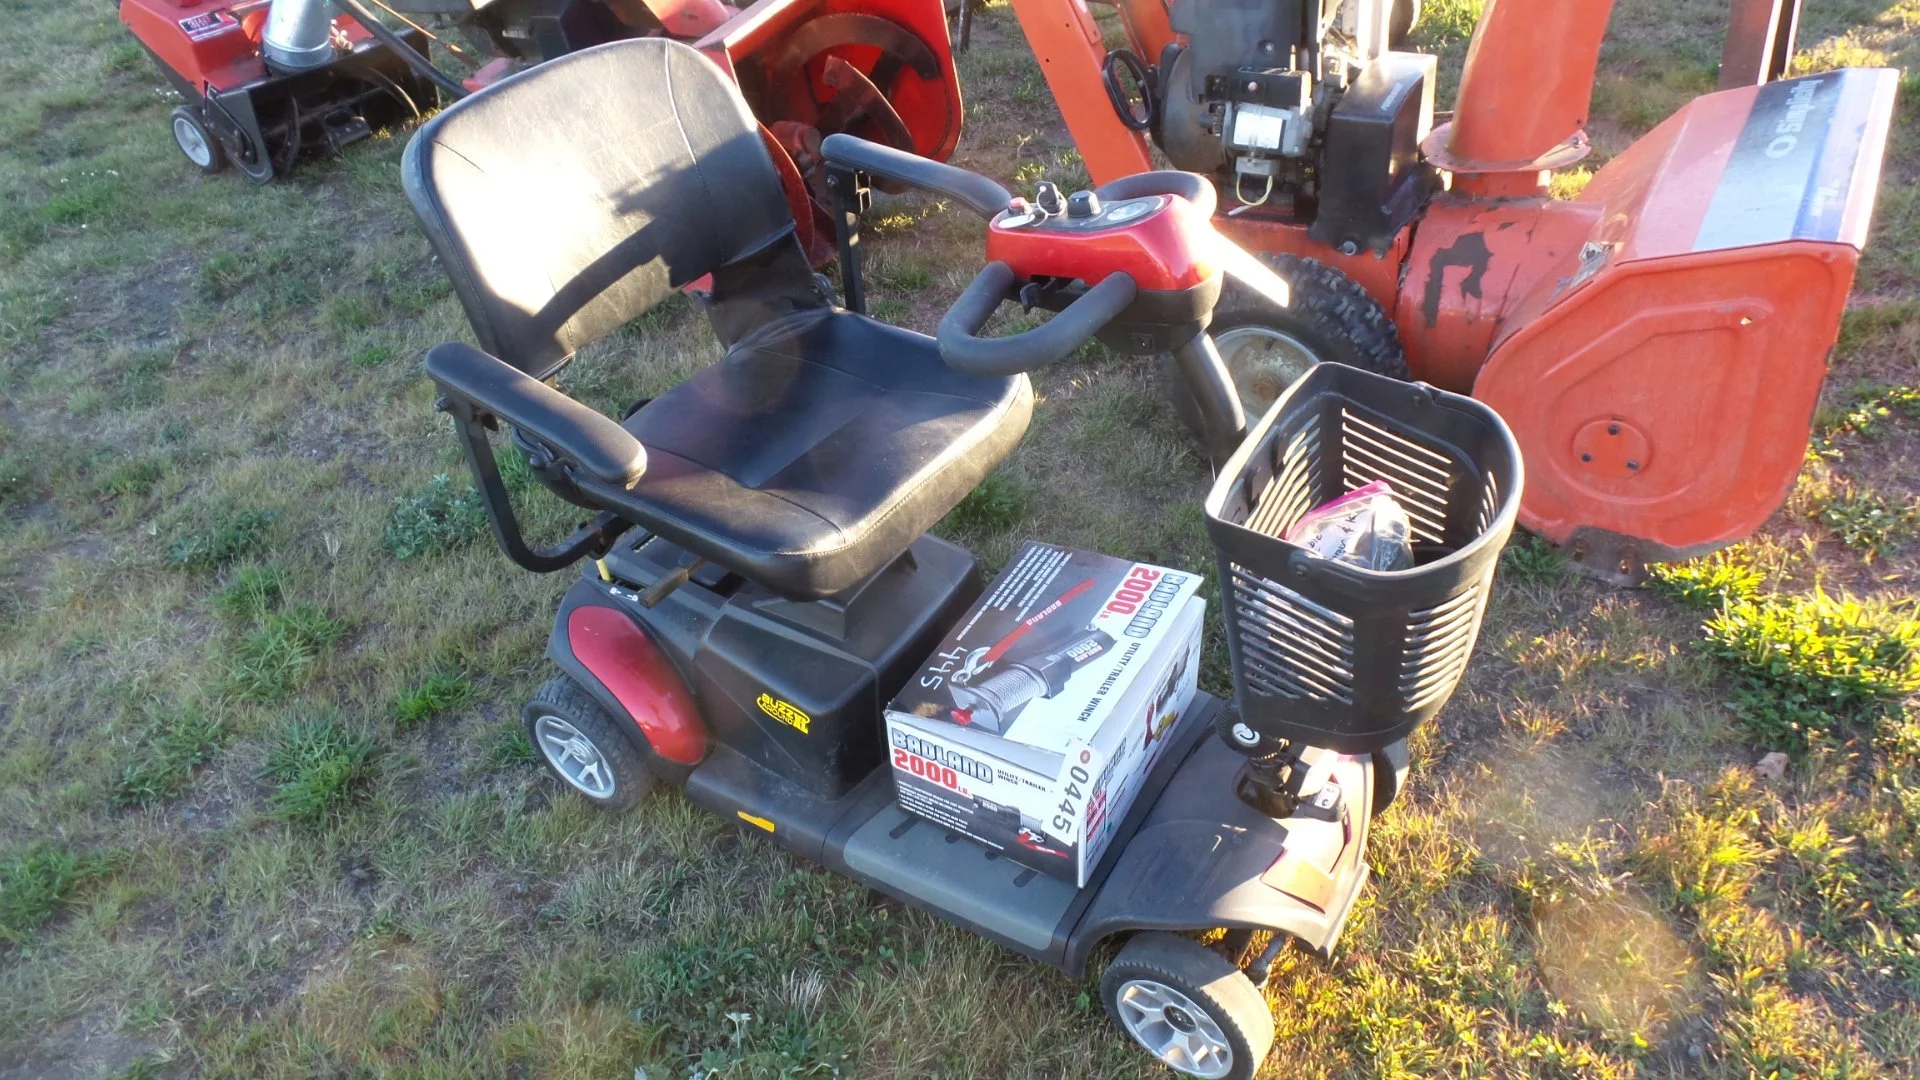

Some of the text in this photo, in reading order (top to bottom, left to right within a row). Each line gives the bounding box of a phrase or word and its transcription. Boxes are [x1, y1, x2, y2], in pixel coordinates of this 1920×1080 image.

[1106, 566, 1161, 615] 2000
[1124, 572, 1188, 638] BADLAND
[921, 646, 968, 690] 445
[762, 693, 794, 719] BUZZ
[762, 703, 794, 725] AROUND
[1077, 697, 1103, 722] WINCH
[892, 727, 994, 783] BADLAND
[894, 748, 957, 790] 2000
[1053, 765, 1089, 834] 0445
